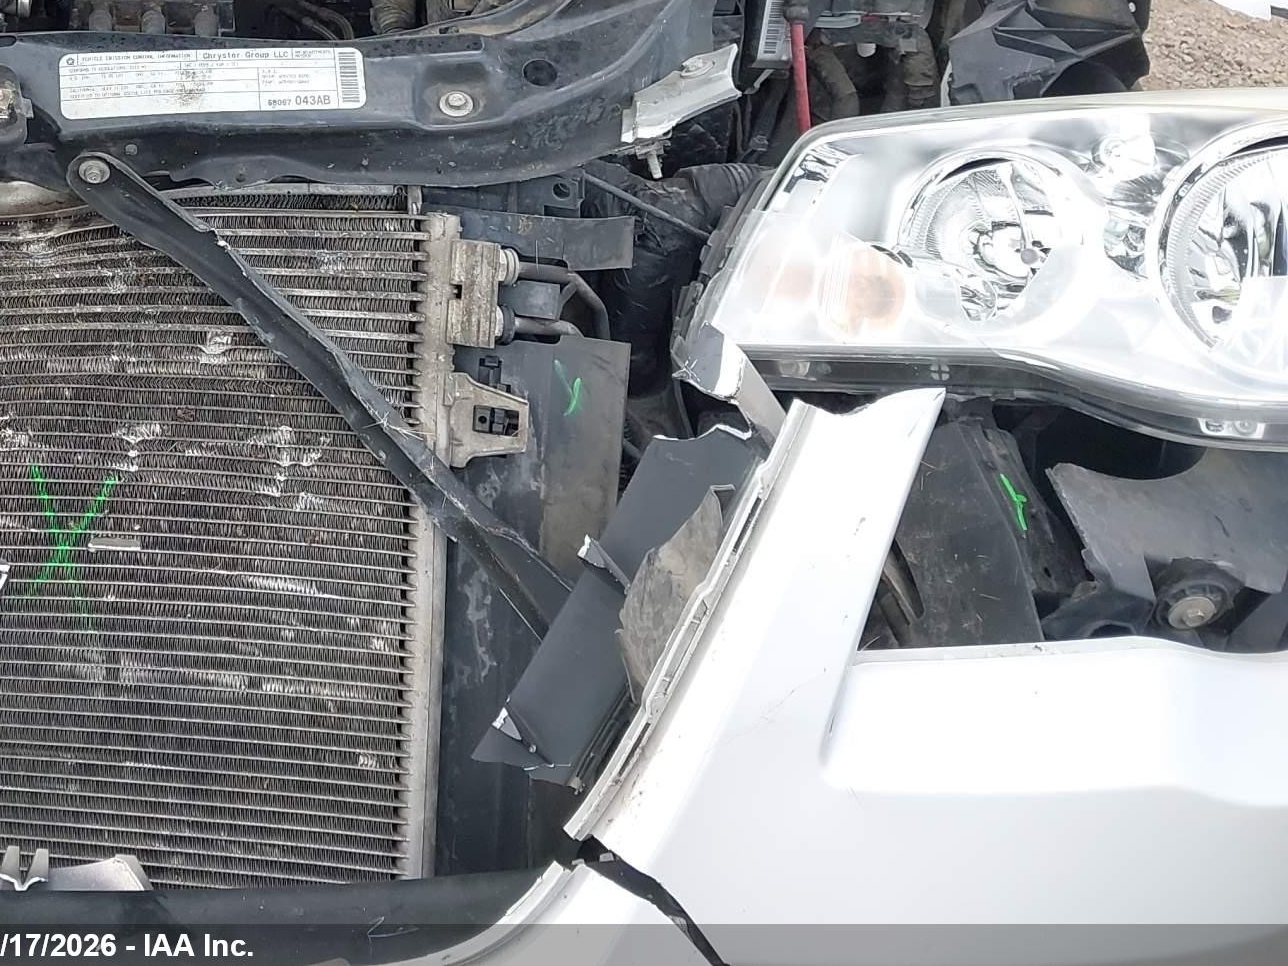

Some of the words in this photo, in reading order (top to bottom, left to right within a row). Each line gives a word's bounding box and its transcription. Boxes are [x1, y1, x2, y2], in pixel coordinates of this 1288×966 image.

[245, 50, 270, 59] Group
[273, 50, 289, 58] LLC
[295, 95, 331, 105] 043AB
